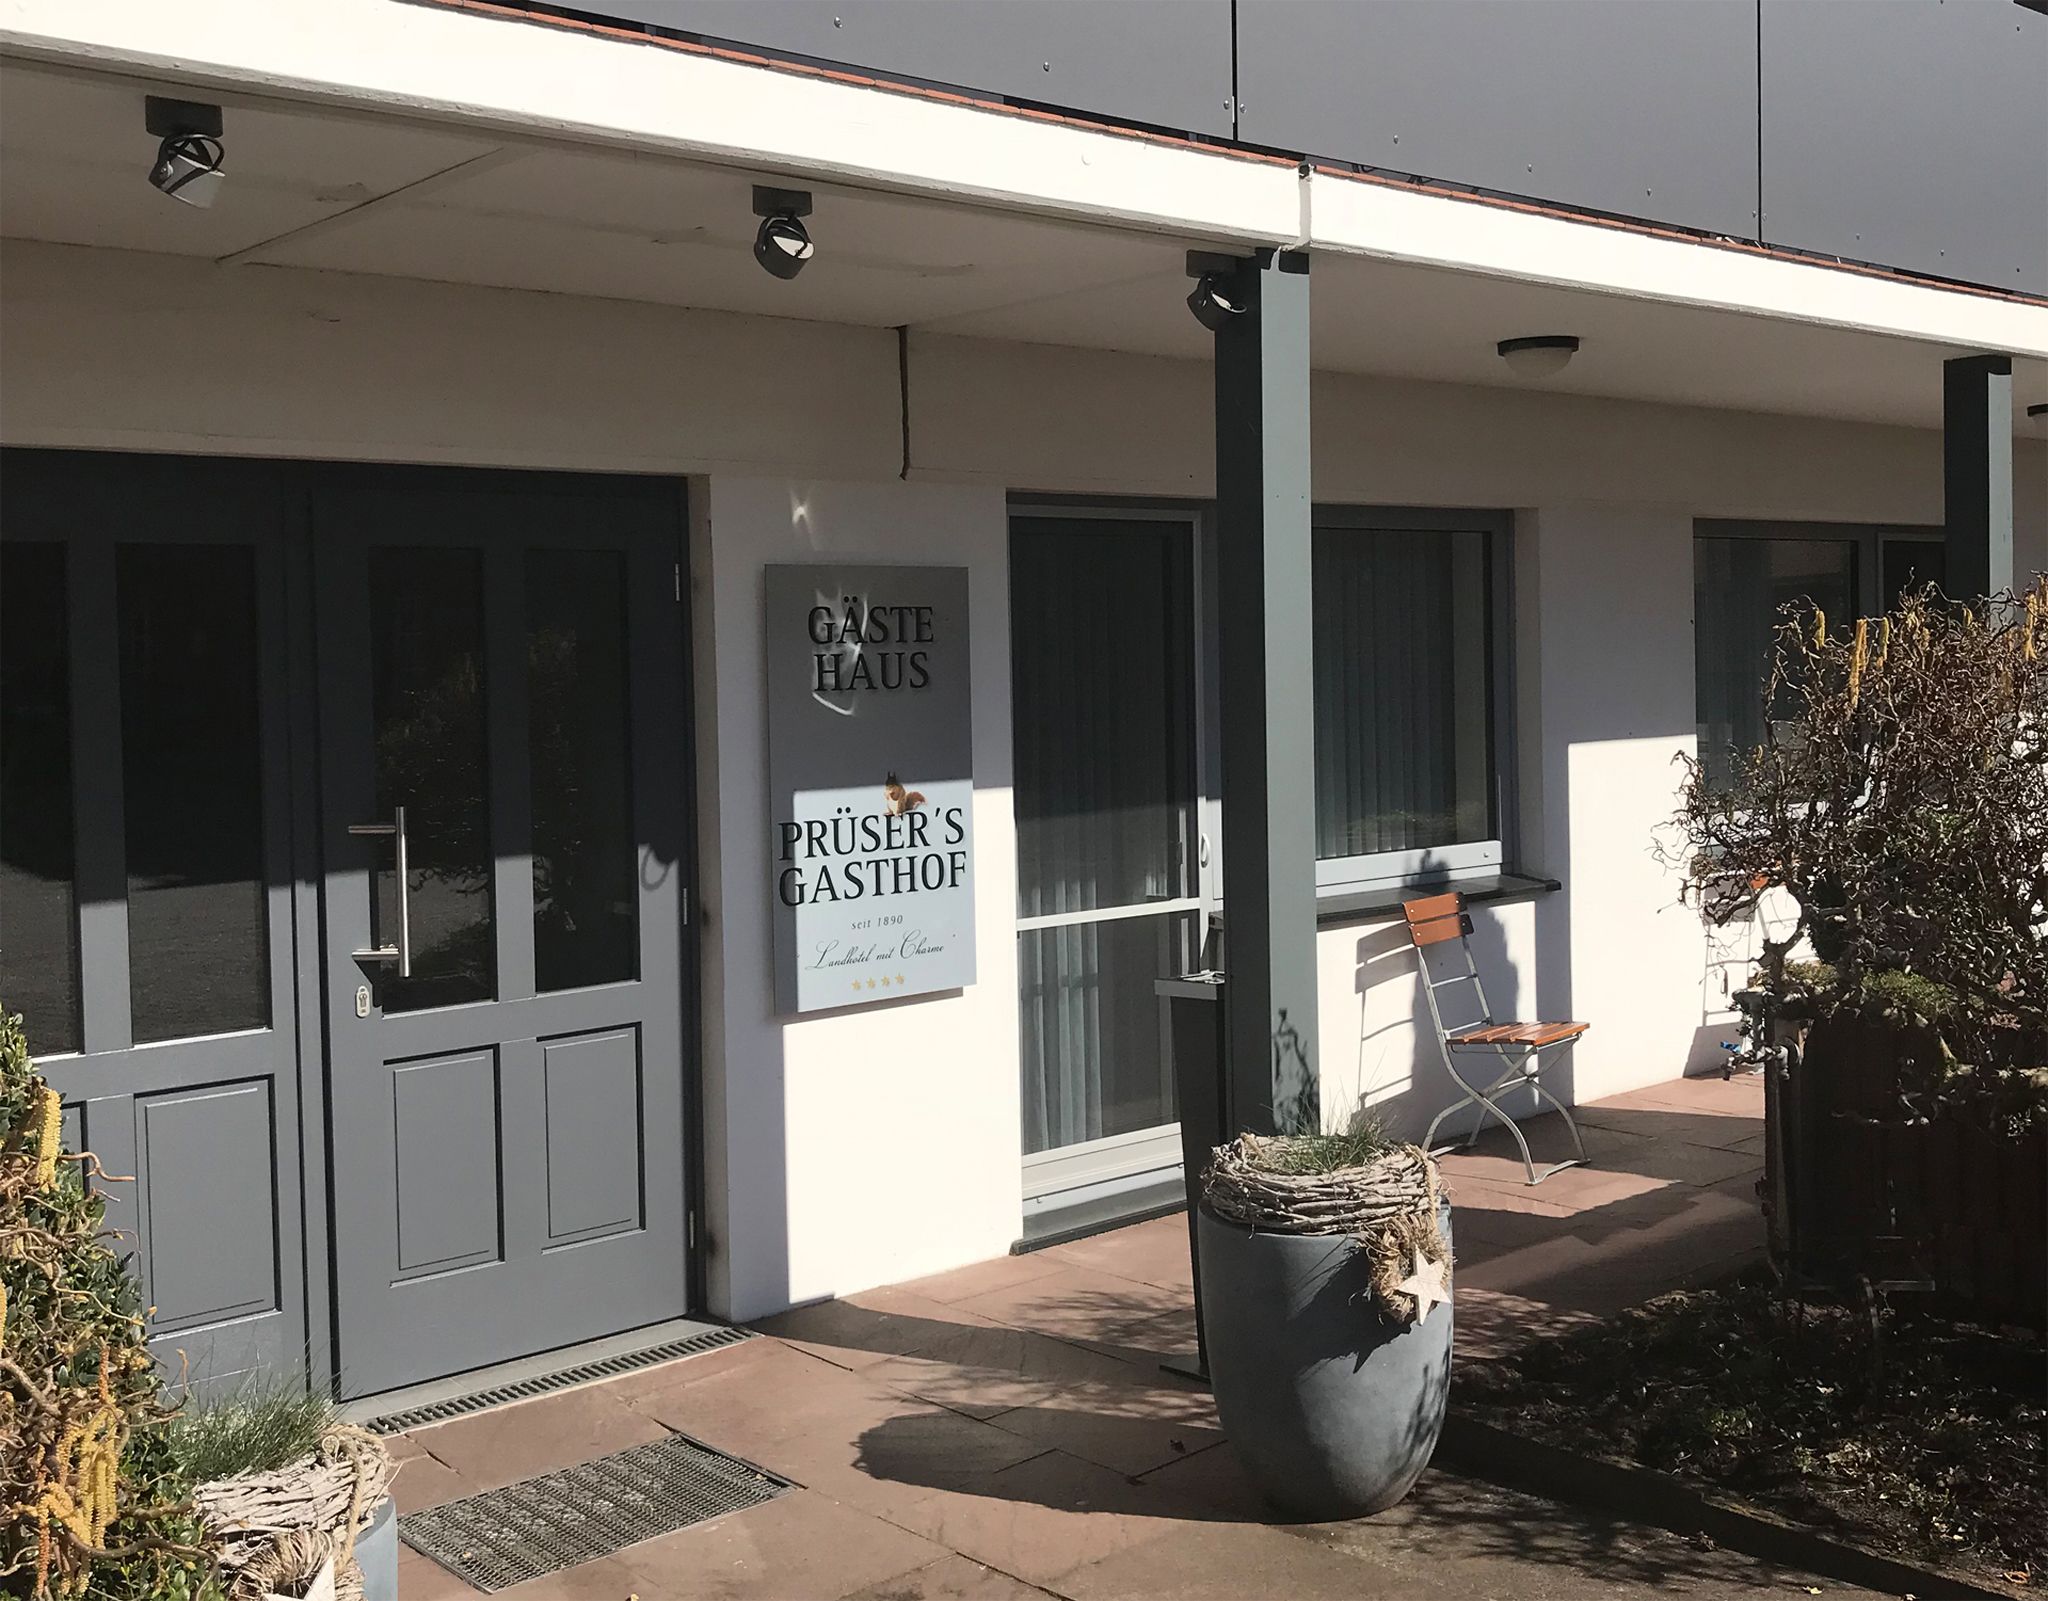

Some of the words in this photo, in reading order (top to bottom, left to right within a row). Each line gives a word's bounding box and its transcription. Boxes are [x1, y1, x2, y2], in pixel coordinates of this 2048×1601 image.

[808, 595, 934, 646] GÄSTE
[814, 651, 929, 692] HAUS
[779, 850, 967, 907] GASTHOF
[851, 919, 871, 930] seit
[877, 915, 903, 927] 1890
[805, 940, 876, 970] Landhotel
[876, 946, 895, 960] mit
[900, 929, 944, 959] Charme
